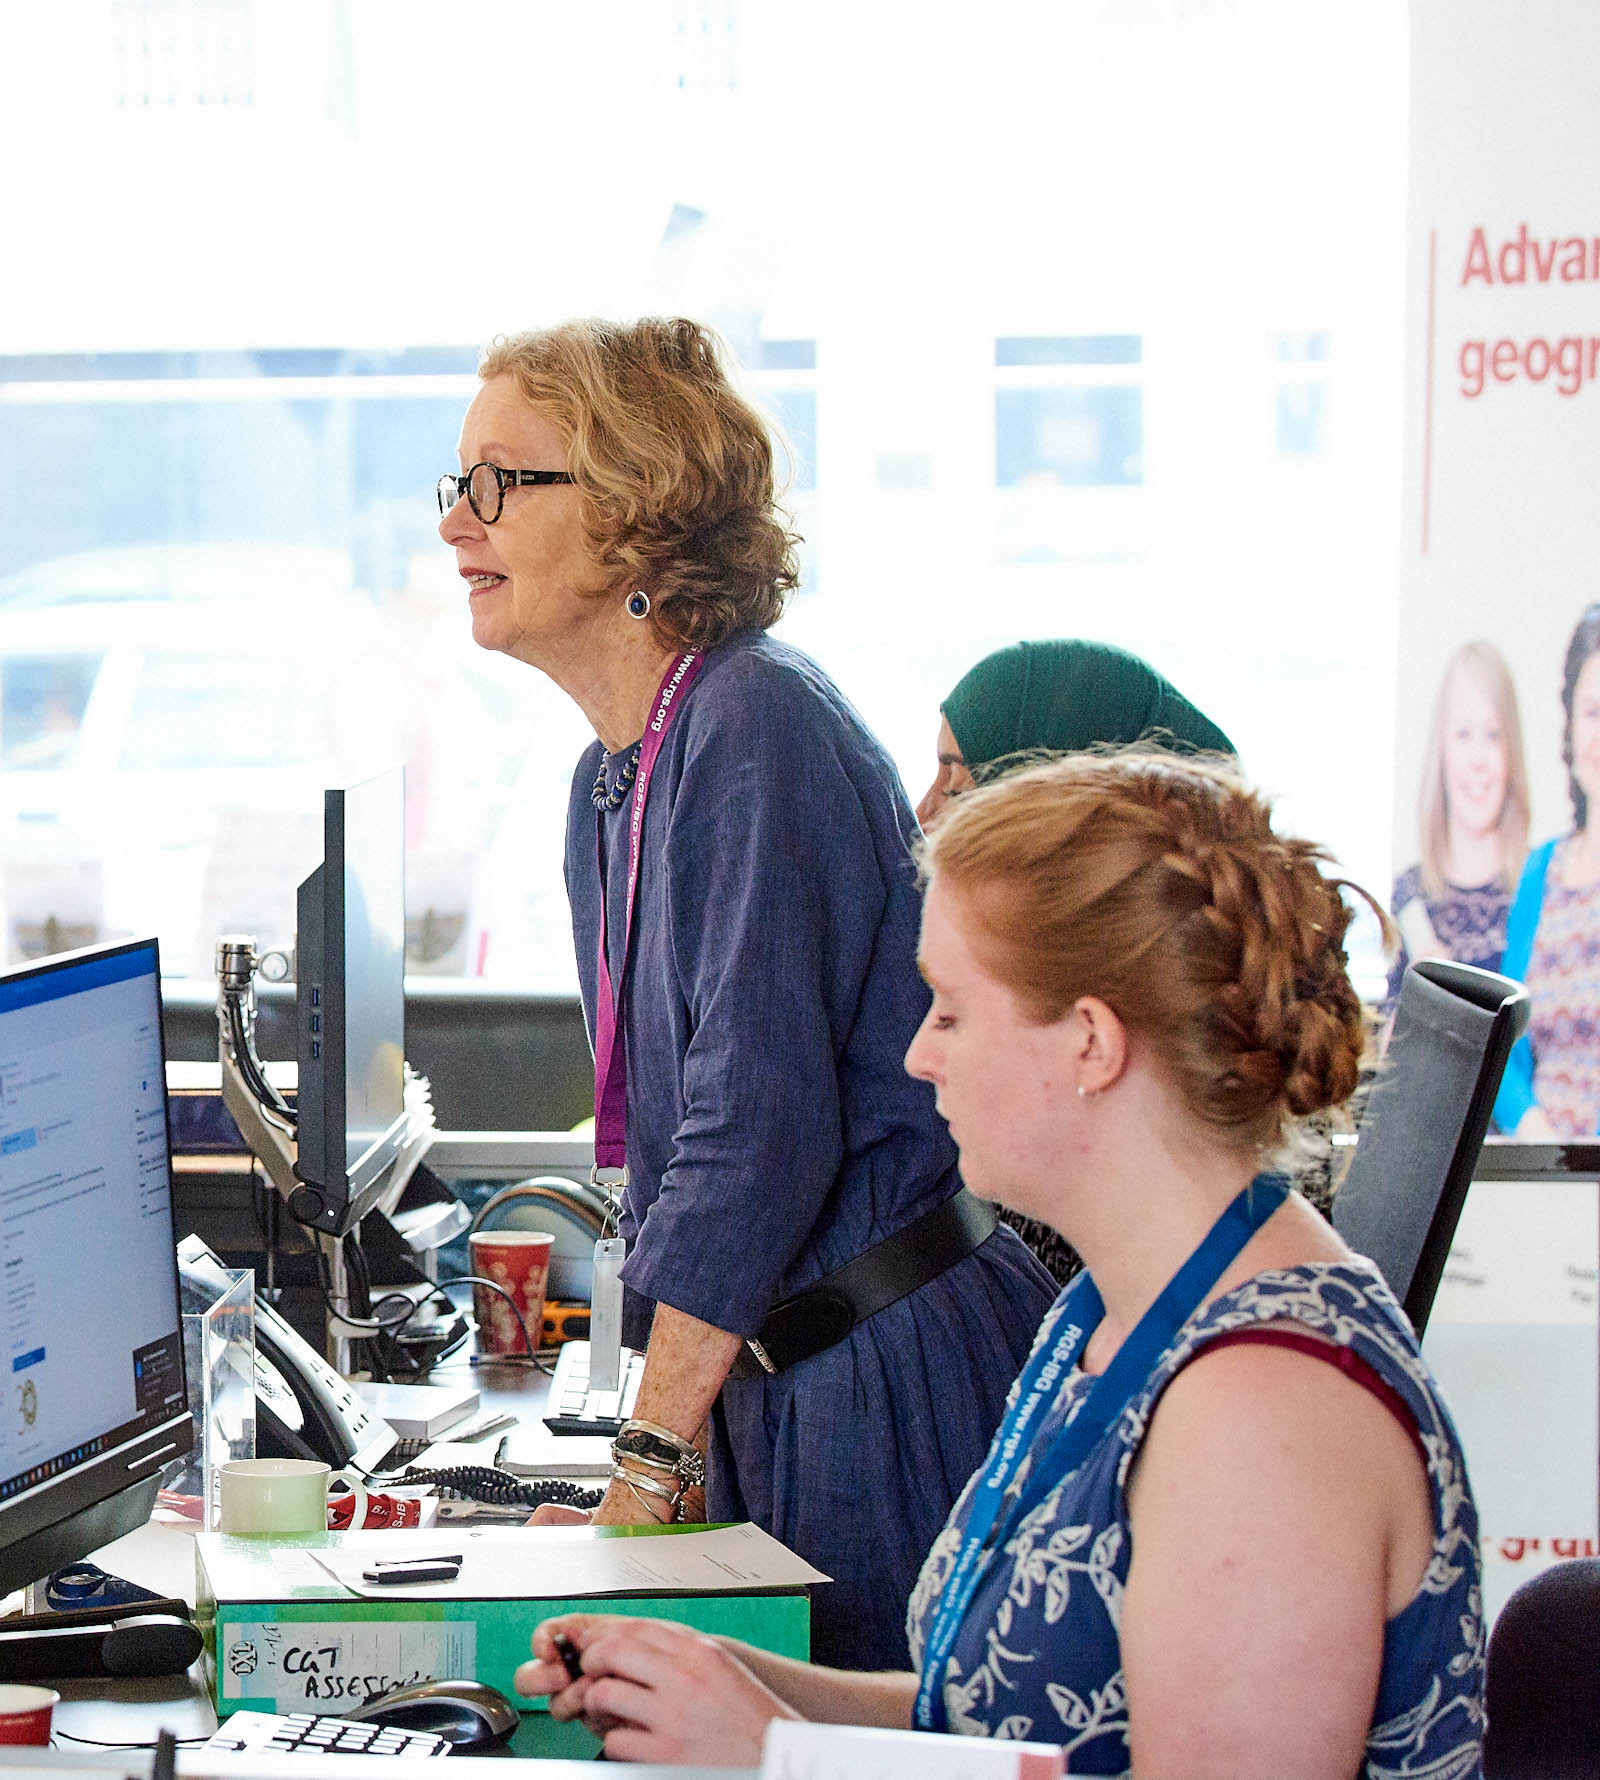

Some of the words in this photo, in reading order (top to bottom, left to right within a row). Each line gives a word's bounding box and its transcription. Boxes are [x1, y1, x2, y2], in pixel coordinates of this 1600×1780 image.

[650, 653, 696, 733] www.rgs.org
[625, 835, 639, 921] www.rg
[1033, 1323, 1084, 1392] RGS-IBG
